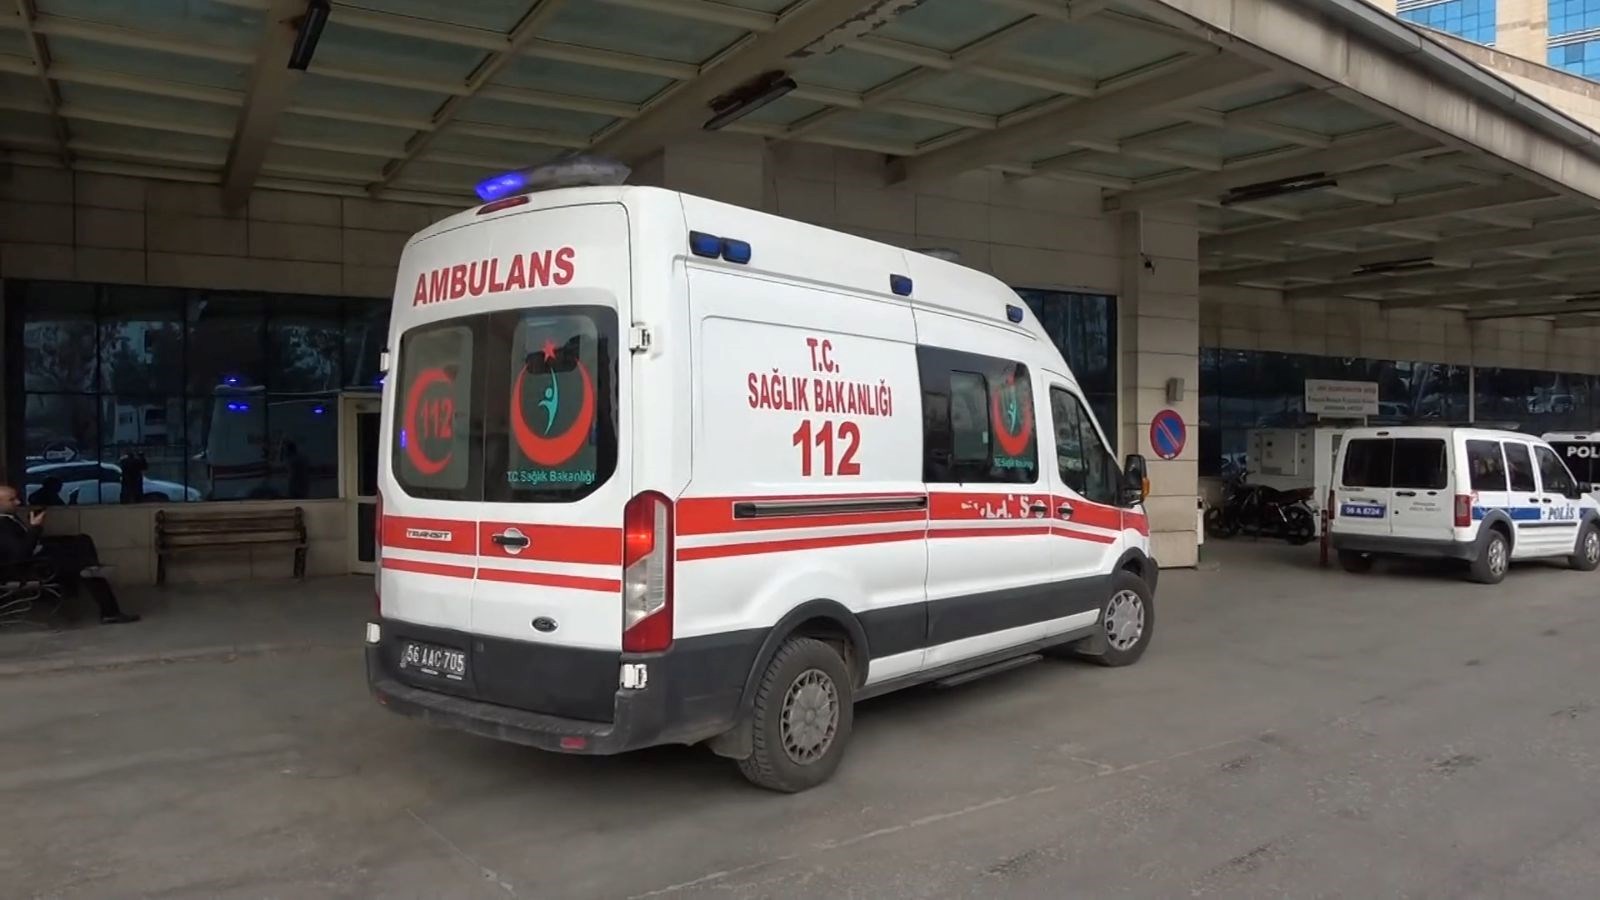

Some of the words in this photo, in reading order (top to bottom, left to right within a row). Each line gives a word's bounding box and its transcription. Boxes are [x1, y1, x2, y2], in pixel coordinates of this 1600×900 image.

[412, 247, 576, 307] AMBULANS
[806, 338, 839, 373] T.C.
[748, 368, 809, 411] SAĞLIK
[814, 379, 893, 416] BAKANLIĞI
[420, 398, 454, 439] 112
[793, 419, 861, 477] 112
[407, 644, 420, 662] 56
[421, 648, 442, 667] AAC
[443, 652, 465, 672] 705
